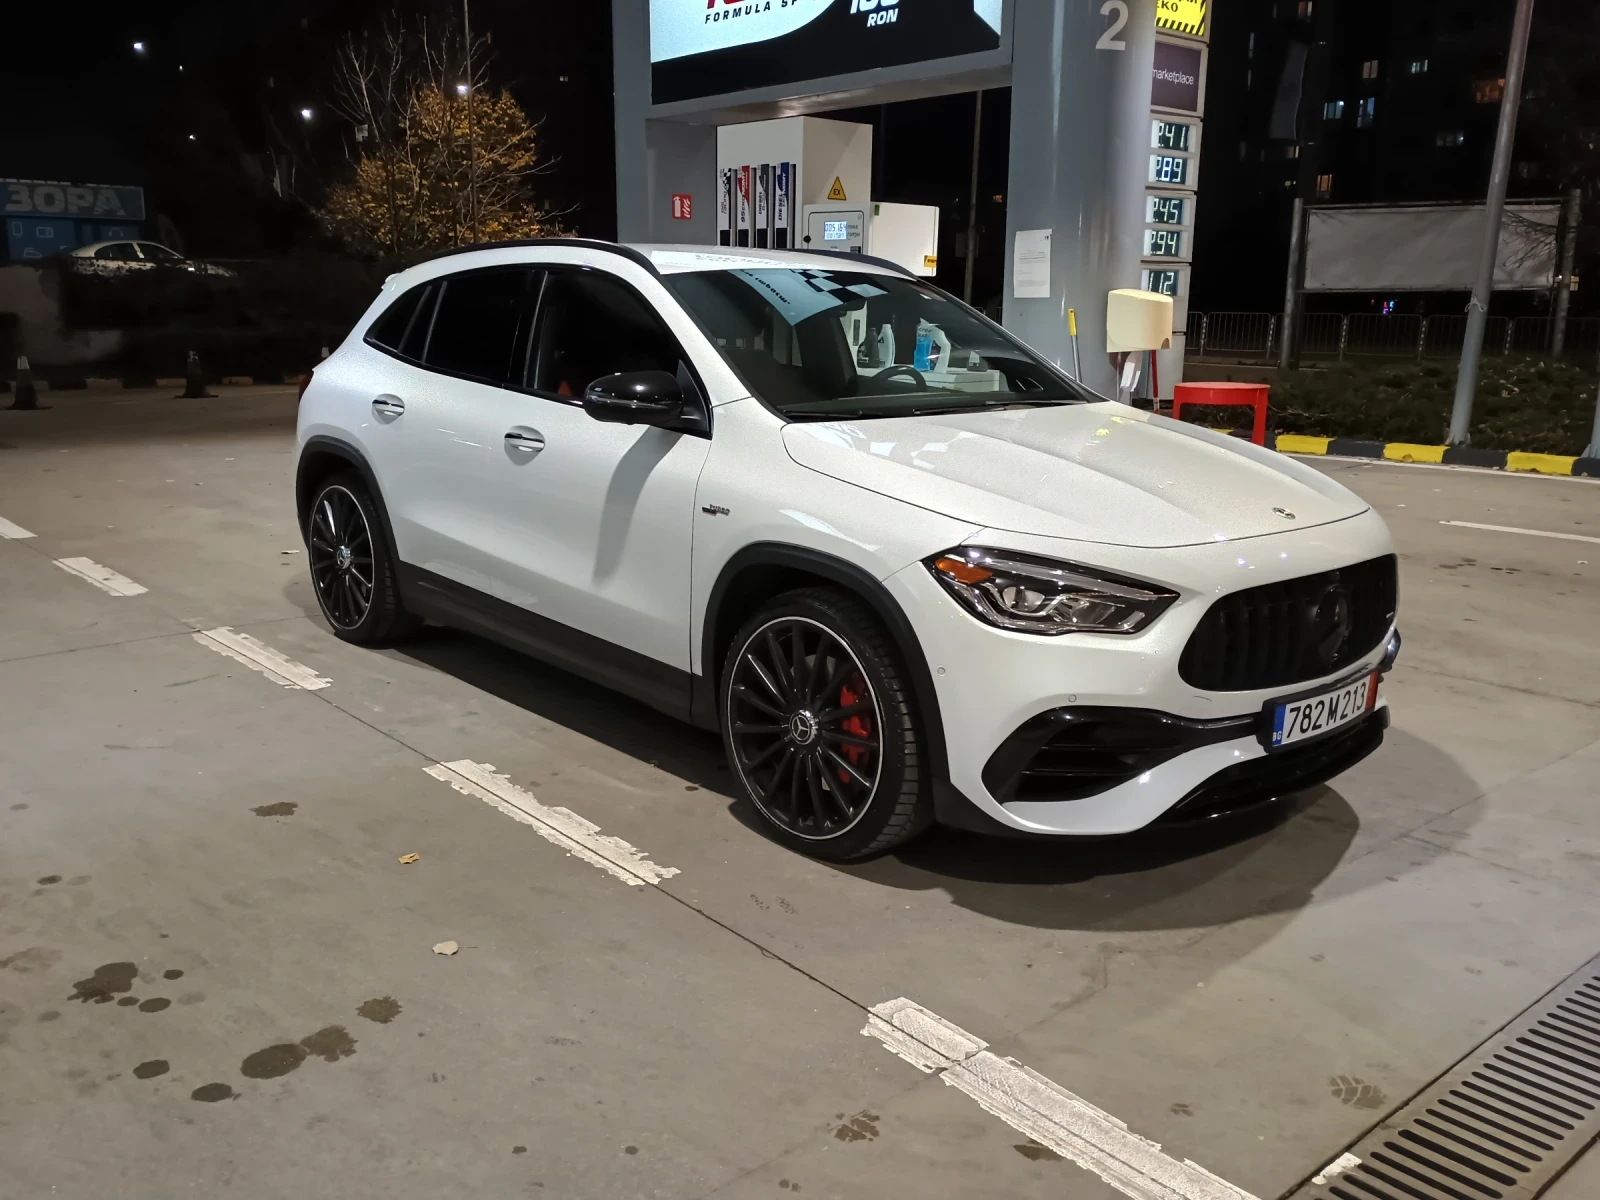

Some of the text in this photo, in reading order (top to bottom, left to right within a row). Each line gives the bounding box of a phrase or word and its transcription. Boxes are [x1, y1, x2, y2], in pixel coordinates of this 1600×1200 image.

[705, 1, 771, 24] FORMULA
[867, 8, 899, 27] RON
[1095, 0, 1129, 51] 2
[1152, 67, 1194, 86] marketplace
[5, 184, 126, 216] ЗОРА
[833, 188, 841, 196] EX
[1272, 730, 1283, 741] BG
